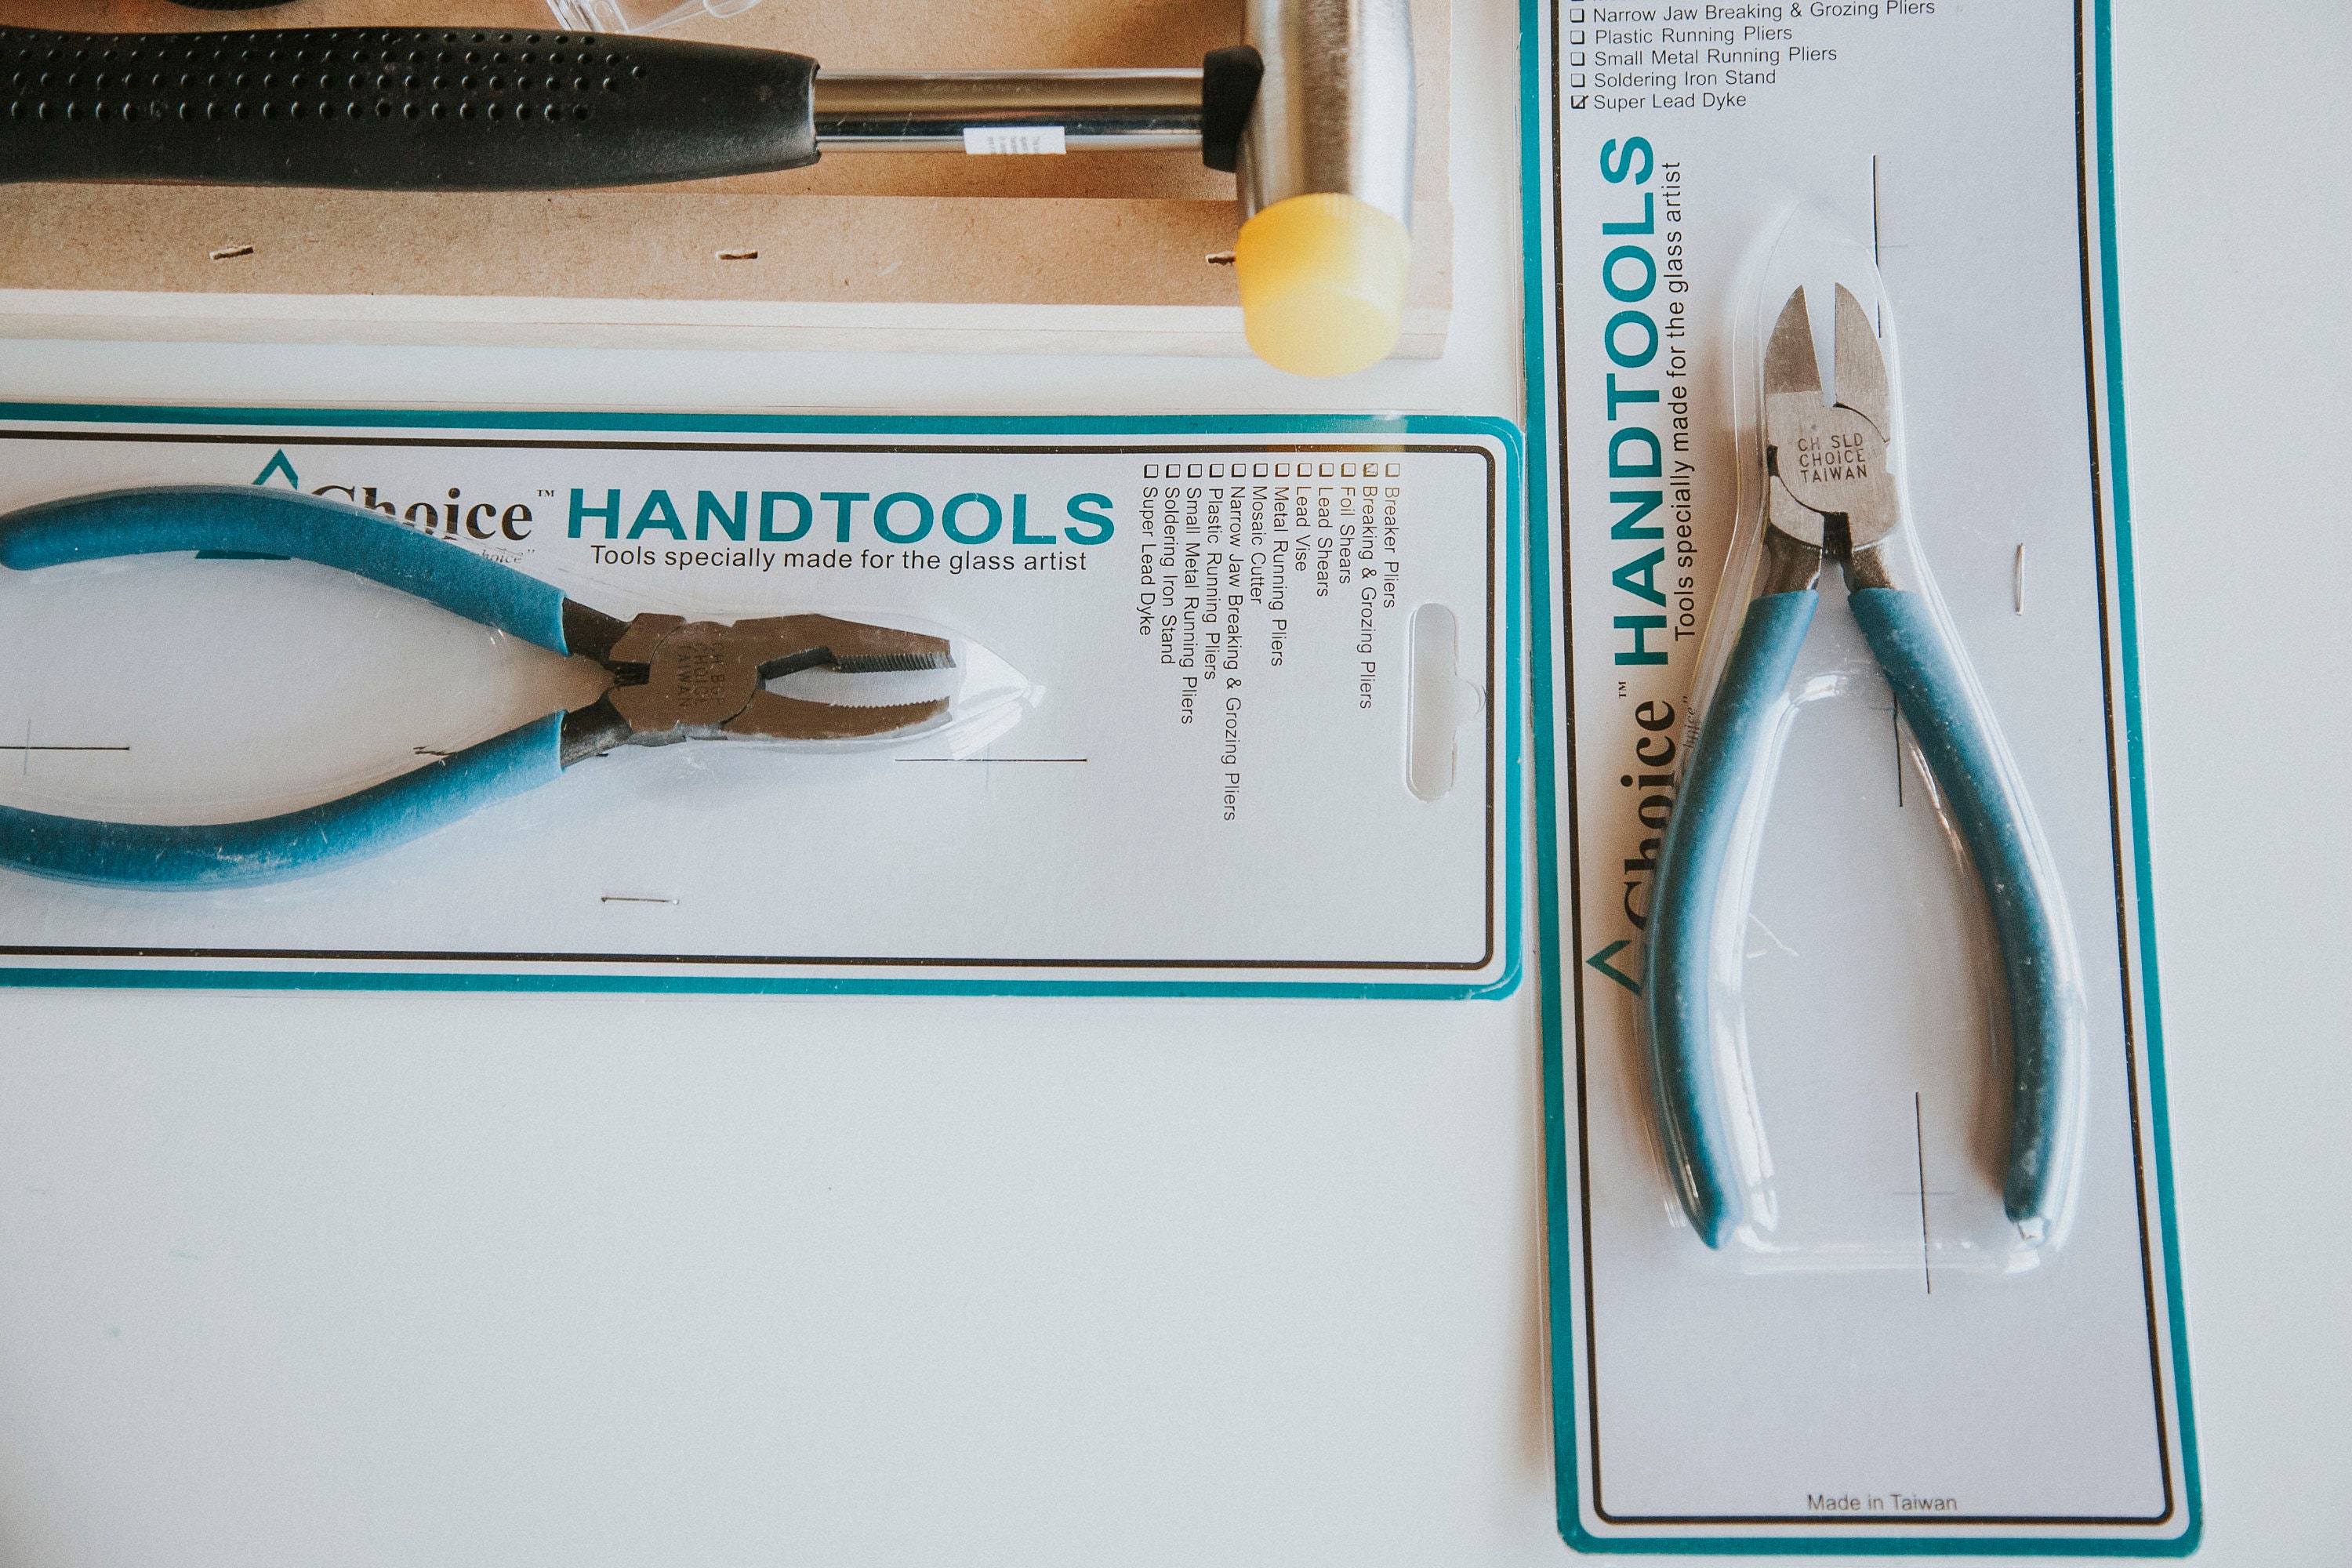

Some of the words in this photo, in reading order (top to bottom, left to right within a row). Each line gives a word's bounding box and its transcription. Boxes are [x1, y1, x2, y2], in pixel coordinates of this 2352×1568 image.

[1594, 8, 1656, 23] Narrow
[1664, 6, 1697, 20] Jaw
[1706, 3, 1781, 22] Breaking
[1791, 2, 1802, 17] &
[1810, 1, 1878, 20] Grozing
[1887, 0, 1935, 14] Pliers
[1595, 50, 1642, 66] Small
[1652, 49, 1697, 64] Metal
[1708, 48, 1779, 66] Running
[1789, 46, 1837, 61] Pliers
[1596, 29, 1652, 44] Plastic
[1663, 27, 1733, 45] Running
[1744, 26, 1792, 41] Pliers
[1594, 95, 1646, 112] Super
[1653, 93, 1694, 108] Lead
[1704, 92, 1746, 111] Dyke
[1595, 72, 1675, 89] Soldering
[1686, 71, 1717, 85] Iron
[1726, 69, 1775, 85] Stand
[1661, 162, 1681, 222] artist
[1664, 231, 1689, 293] glass
[1665, 302, 1685, 339] the
[1666, 347, 1686, 378] for
[1600, 136, 1669, 666] HANDTOOLS
[1668, 387, 1692, 452] made
[1798, 437, 1820, 452] CH
[1831, 433, 1863, 448] SLD
[311, 485, 533, 541] hoice
[568, 488, 1114, 545] HANDTOOLS
[1139, 487, 1158, 537] Super
[1186, 488, 1202, 533] Small
[1207, 488, 1223, 543] Plastic
[1229, 487, 1245, 546] Narrow
[1251, 486, 1267, 545] Mosaic
[1274, 487, 1289, 532] Metal
[1296, 487, 1312, 527] Lead
[1318, 488, 1334, 528] Lead
[1341, 487, 1356, 515] Foil
[1358, 486, 1377, 559] Breaking
[1385, 488, 1399, 554] Breaker
[1670, 465, 1699, 572] specially
[1160, 487, 1180, 566] Soldering
[590, 545, 655, 565] Tools
[665, 547, 775, 572] specially
[784, 549, 852, 568] made
[861, 549, 895, 568] for
[902, 550, 940, 569] the
[950, 550, 1014, 575] glass
[1024, 551, 1086, 570] artist
[1141, 544, 1156, 585] Lead
[1185, 543, 1200, 588] Metal
[1229, 554, 1244, 587] Jaw
[1269, 541, 1288, 610] Running
[1295, 535, 1311, 571] Vise
[1317, 537, 1333, 597] Shears
[1339, 524, 1355, 583] Shears
[1362, 568, 1377, 579] &
[1163, 575, 1178, 606] Iron
[1202, 553, 1222, 622] Running
[1250, 553, 1266, 604] Cutter
[1384, 562, 1399, 608] Pliers
[1137, 593, 1156, 635] Dyke
[1179, 597, 1199, 667] Running
[1223, 595, 1243, 670] Breaking
[1357, 589, 1377, 653] Grozing
[1674, 577, 1697, 644] Tools
[1161, 615, 1177, 663] Stand
[1204, 633, 1220, 680] Pliers
[1271, 619, 1287, 666] Pliers
[1181, 677, 1197, 724] Pliers
[1226, 677, 1241, 689] &
[1360, 662, 1375, 709] Pliers
[1221, 698, 1241, 764] Grozing
[1224, 773, 1240, 820] Pliers
[1808, 1494, 1860, 1511] Made
[1868, 1494, 1884, 1510] in
[1890, 1494, 1957, 1511] Taiwan
